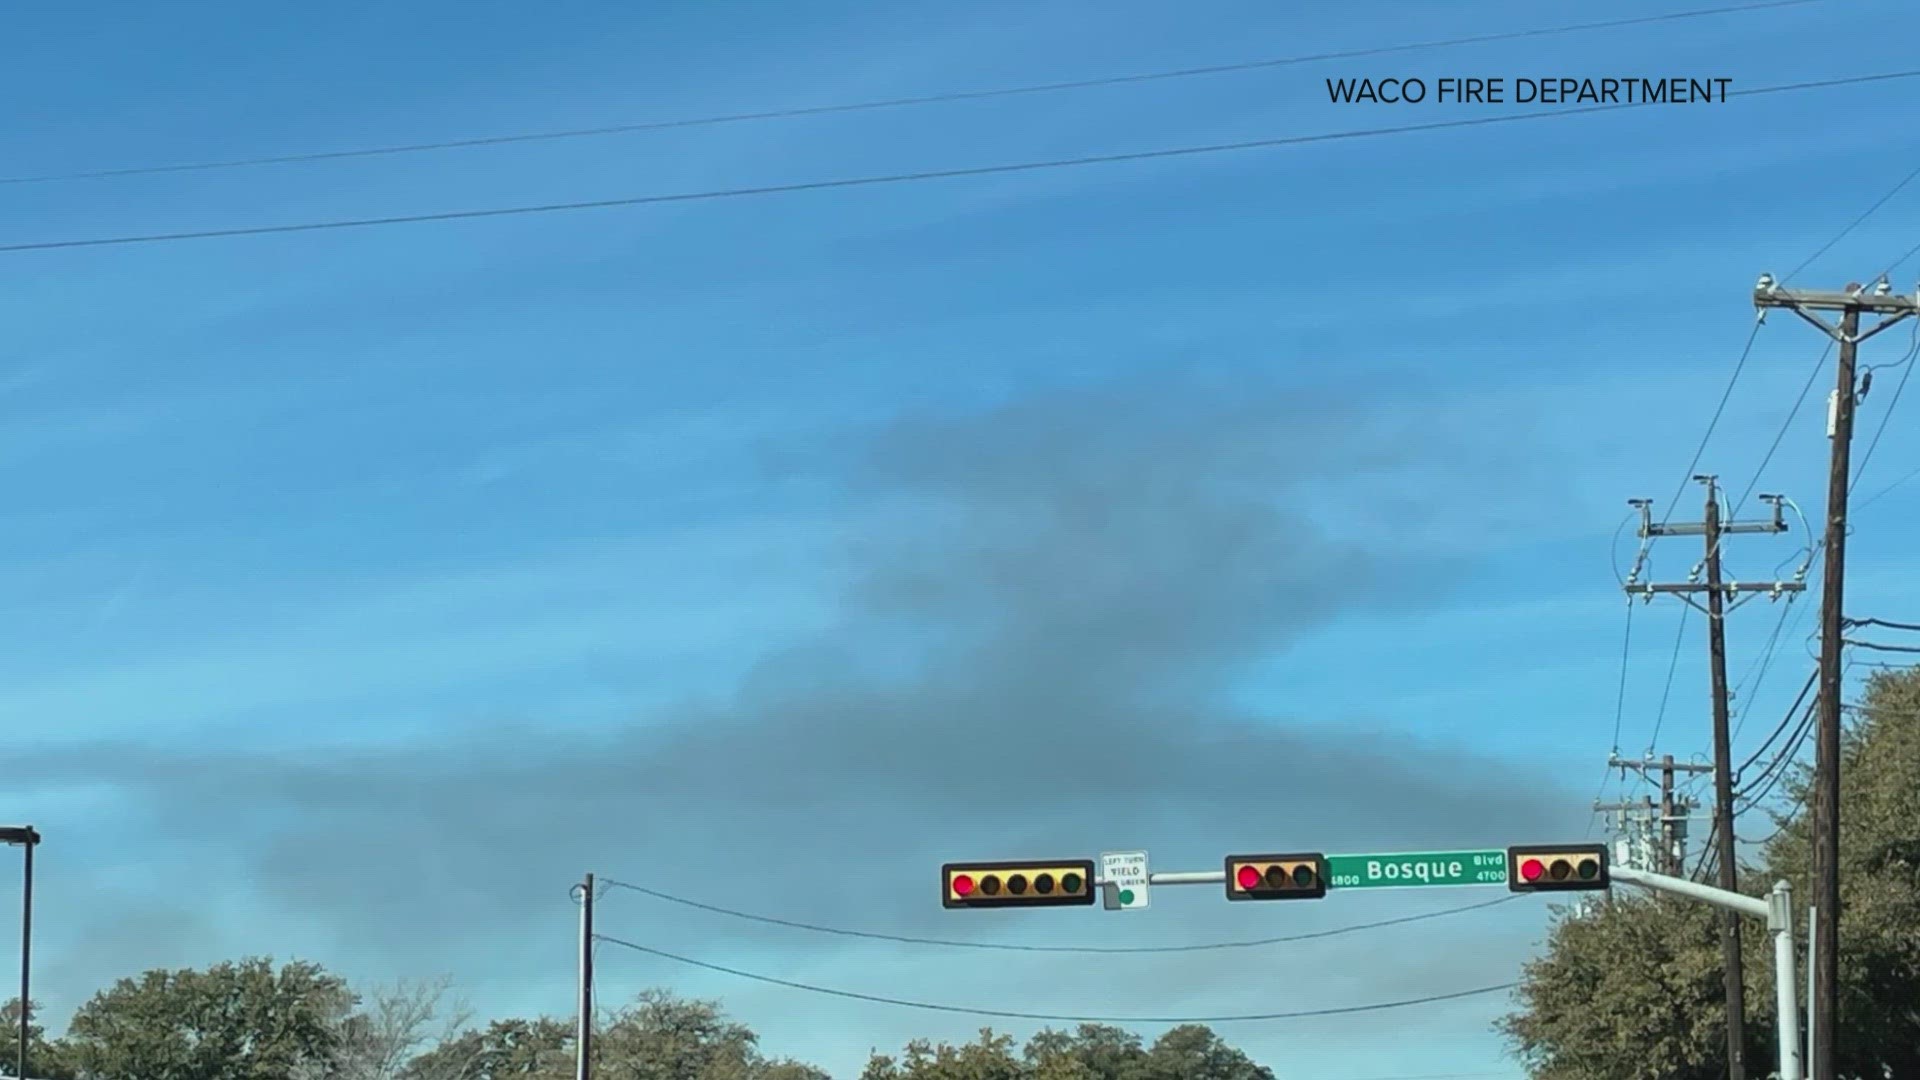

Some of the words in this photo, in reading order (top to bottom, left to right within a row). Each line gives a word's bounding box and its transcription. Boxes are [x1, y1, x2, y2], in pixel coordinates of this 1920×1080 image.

[1104, 857, 1121, 866] LEFT
[1124, 856, 1145, 864] TURN
[1111, 866, 1140, 876] YIELD
[1367, 861, 1463, 883] Bosque
[1474, 855, 1503, 866] Blvd
[1476, 870, 1506, 881] 4700
[1121, 879, 1146, 887] GREEN
